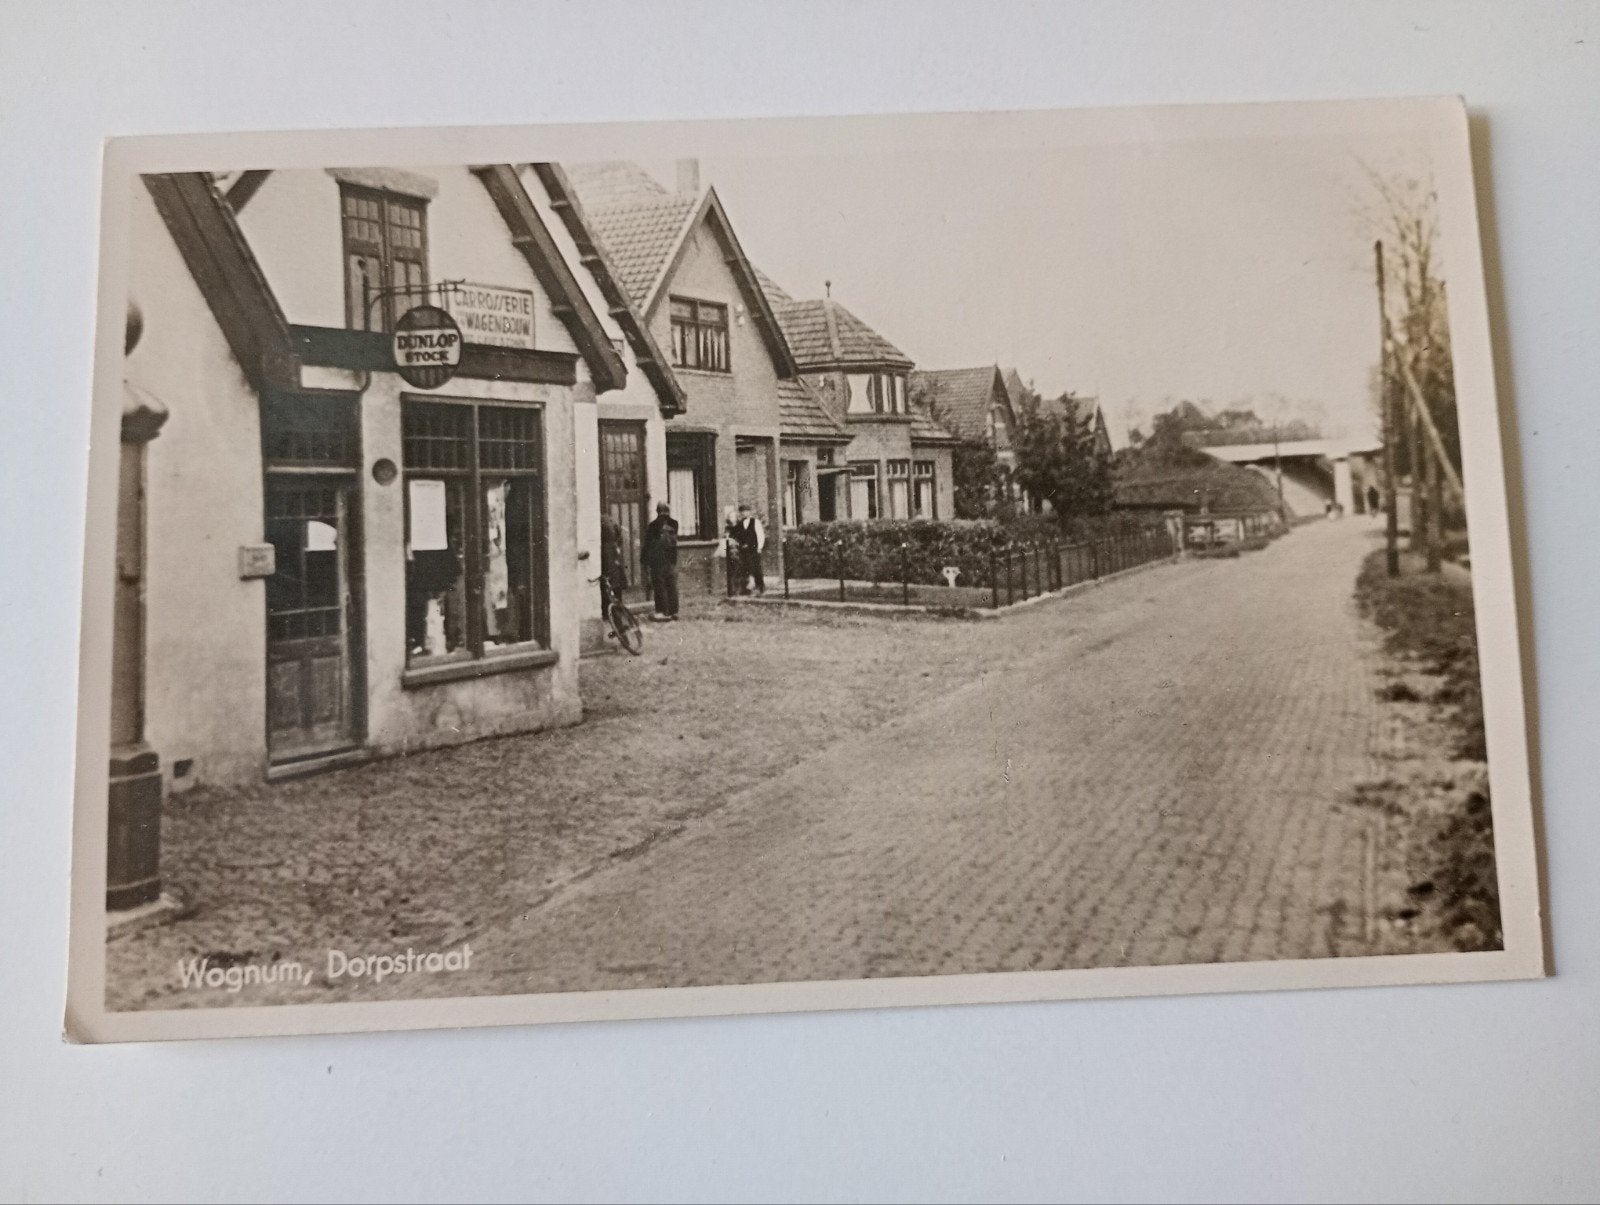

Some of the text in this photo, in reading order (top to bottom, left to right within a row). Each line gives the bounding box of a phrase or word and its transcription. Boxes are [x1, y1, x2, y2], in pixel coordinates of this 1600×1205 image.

[454, 289, 530, 315] CARROSSERIE
[466, 312, 530, 336] WAGENBOUW
[397, 333, 458, 349] DUNLOP
[405, 351, 449, 363] STOCK
[178, 943, 474, 993] Wognum, Dorpstraat
